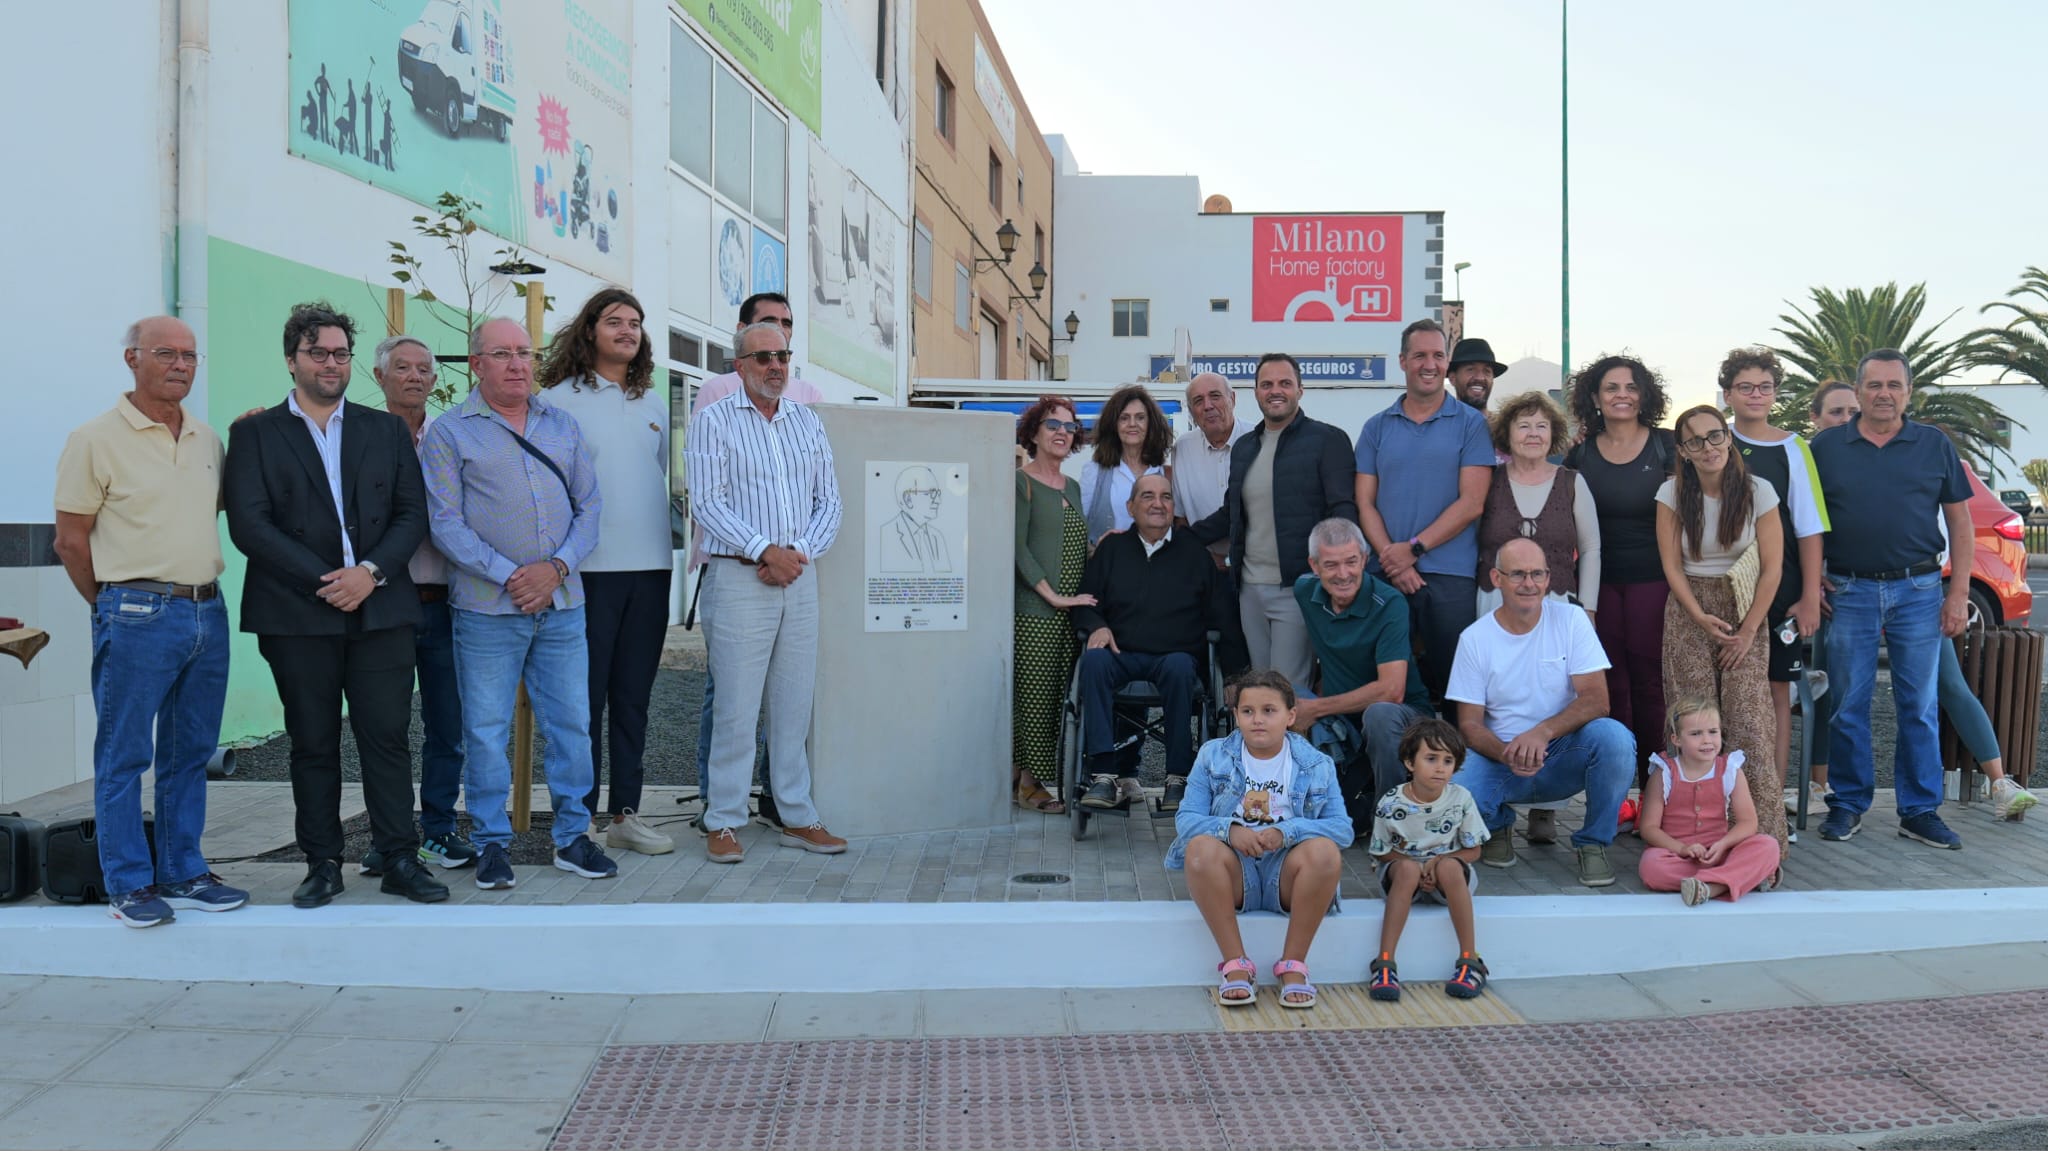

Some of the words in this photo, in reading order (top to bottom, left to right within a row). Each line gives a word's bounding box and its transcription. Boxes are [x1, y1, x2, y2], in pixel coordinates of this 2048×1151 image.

[566, 31, 574, 57] A
[1270, 221, 1386, 253] Milano
[1270, 257, 1320, 276] Home
[1326, 257, 1385, 280] factory
[1217, 362, 1259, 375] GESTO
[1299, 362, 1356, 375] SEGUROS
[1245, 775, 1284, 796] APYBARA
